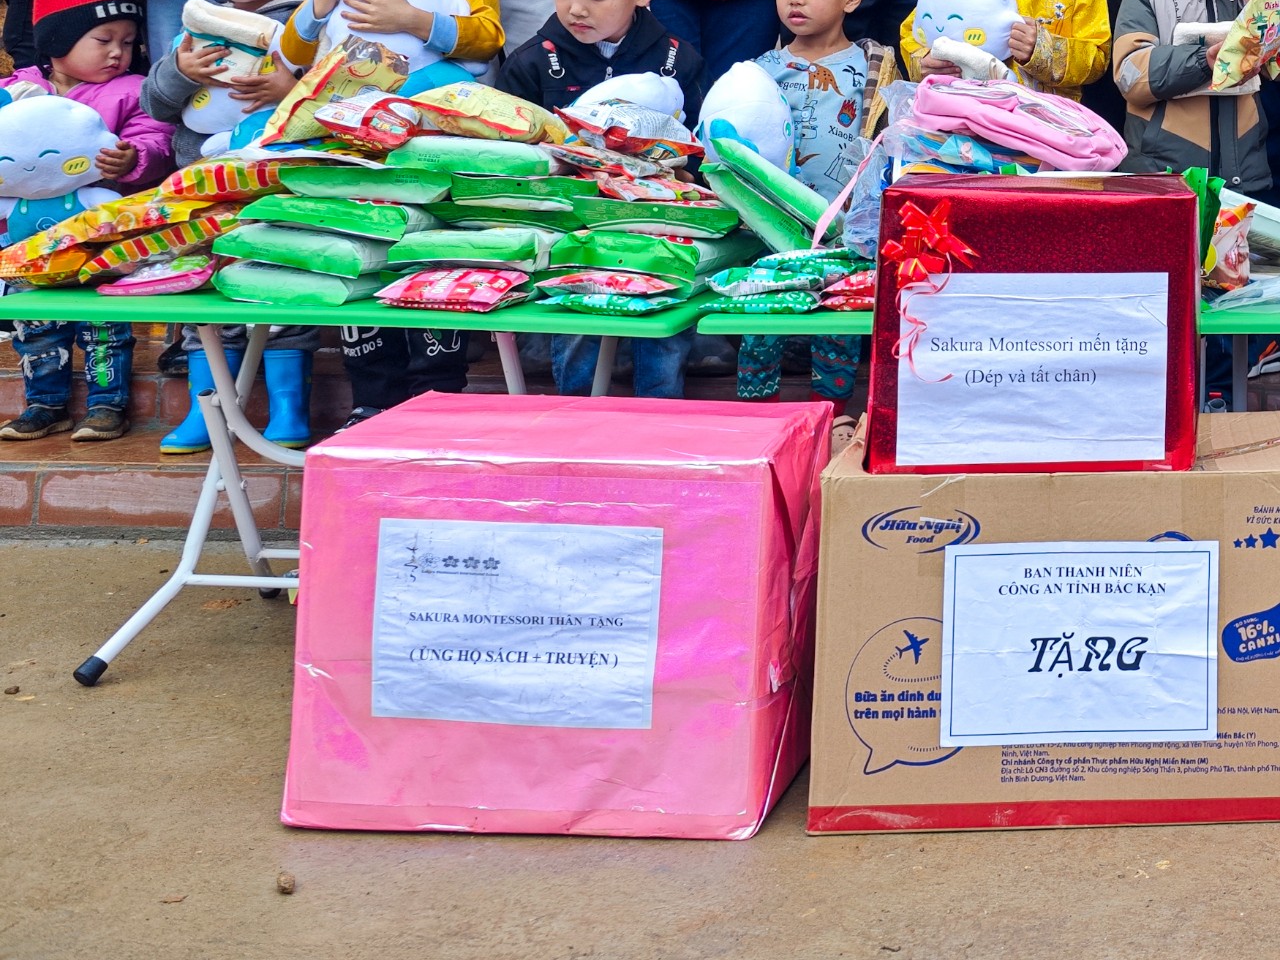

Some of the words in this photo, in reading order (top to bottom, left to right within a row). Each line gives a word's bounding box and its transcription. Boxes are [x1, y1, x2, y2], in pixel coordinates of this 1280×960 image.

[930, 337, 983, 352] Sakura
[989, 337, 1073, 352] Montessori
[1078, 333, 1110, 352] mến
[1116, 338, 1148, 356] tặng
[965, 369, 1003, 388] (Dép
[1009, 369, 1026, 383] và
[1031, 365, 1050, 383] tất
[1054, 369, 1097, 385] chân)
[1253, 505, 1274, 514] BÁNH
[879, 519, 919, 531] Hữu
[919, 517, 963, 534] Nghị
[905, 535, 935, 544] Food
[1024, 567, 1052, 579] BAN
[1056, 566, 1105, 578] THANH
[1109, 564, 1143, 578] NIÊN
[998, 581, 1040, 596] CÔNG
[1043, 583, 1062, 595] AN
[1105, 580, 1133, 594] BẮC
[1137, 583, 1167, 597] KẠN
[409, 612, 460, 624] SAKURA
[463, 614, 544, 626] MONTESSORI
[548, 615, 582, 626] THÂN
[1237, 620, 1275, 641] 16%
[1239, 633, 1280, 653] CANXI
[457, 648, 482, 665] HỘ
[485, 647, 528, 664] SÁCH
[545, 651, 609, 669] TRUYỆN
[1027, 632, 1149, 678] TẶNG
[854, 691, 878, 703] Bữa
[880, 690, 895, 702] ăn
[854, 707, 879, 720] trên
[882, 707, 904, 721] mọi
[907, 707, 937, 719] hành
